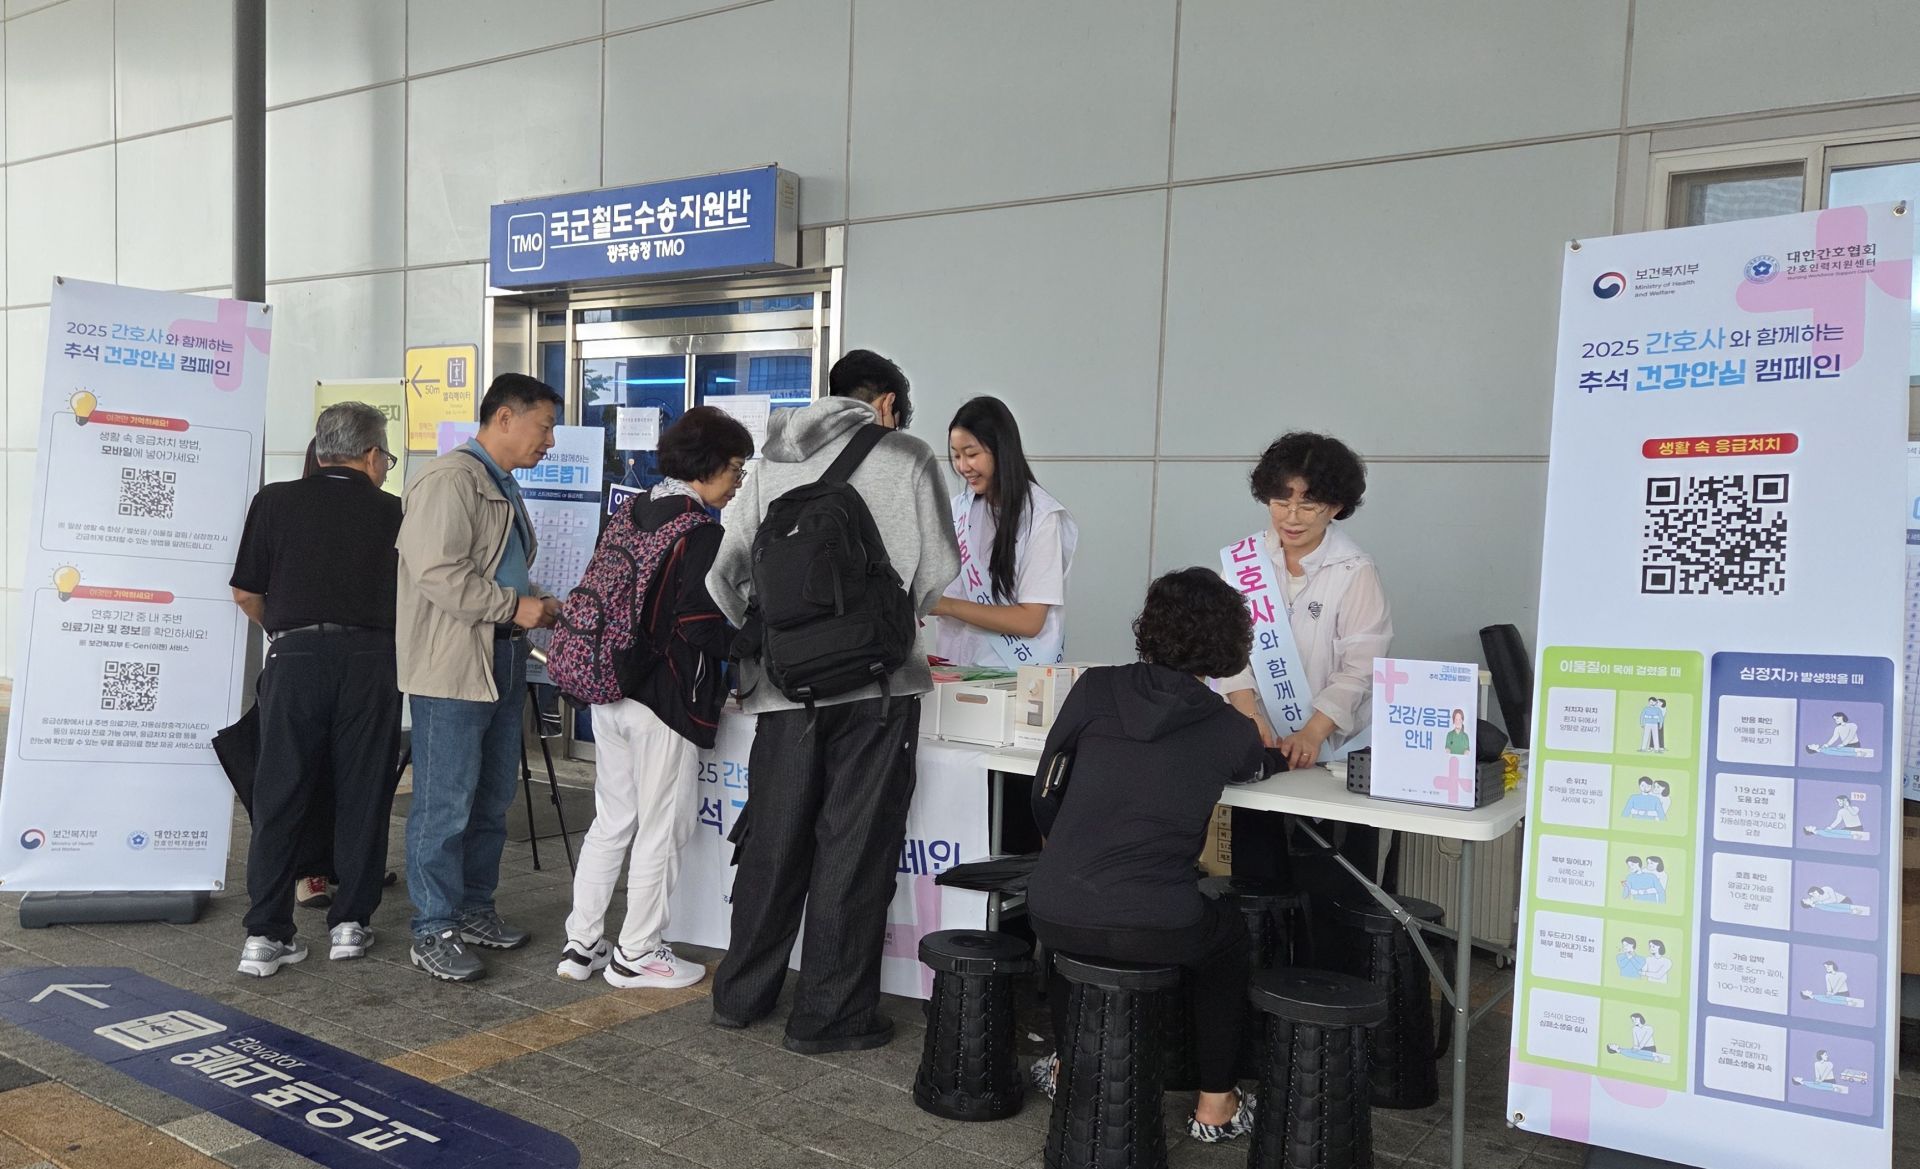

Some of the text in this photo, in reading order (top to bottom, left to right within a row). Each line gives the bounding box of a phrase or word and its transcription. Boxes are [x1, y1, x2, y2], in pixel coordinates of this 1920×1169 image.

[551, 189, 750, 242] 국군철도수송지원반
[512, 233, 542, 253] TMO
[607, 239, 685, 263] 광주송정 TMO
[1787, 243, 1877, 264] 대한간호협회
[1636, 263, 1700, 280] 보건복지부
[1786, 258, 1876, 275] 간호인력지원센터
[1635, 282, 1662, 291] Ministry
[1673, 280, 1695, 288] Health
[66, 322, 234, 352] 2025 간호사와 함께하는
[1582, 323, 1844, 359] 2025 간호사와 함께하는
[64, 342, 230, 376] 추석 건강안심 캠페인
[1579, 354, 1841, 394] 추석 건강안심 캠페인
[425, 385, 440, 394] 50m
[100, 432, 202, 451] 생활 속 응급처치 방법,
[1658, 437, 1781, 456] 생활 속 응급처치
[102, 446, 199, 464] 모바일에 넣어가세요!
[560, 454, 590, 463] 함께하는
[515, 464, 589, 484] 이벤트뽑기
[92, 609, 182, 624] 연휴기간 중 내 주변
[61, 621, 208, 640] 의료기관 및 정보를 확인하세요!
[1560, 660, 1681, 678] 이물질이 목에 걸렸을 때
[1740, 667, 1864, 685] 심정지가 발생했을 때
[1388, 704, 1451, 728] 건강/응급
[1405, 729, 1432, 750] 안내
[1734, 786, 1750, 794] 119
[698, 798, 722, 836] 석
[1744, 809, 1760, 818] 119
[896, 839, 960, 876] 페인
[1746, 966, 1766, 976] 5cm
[228, 1037, 306, 1069] Elevator
[170, 1045, 441, 1151] 엘리베이터
